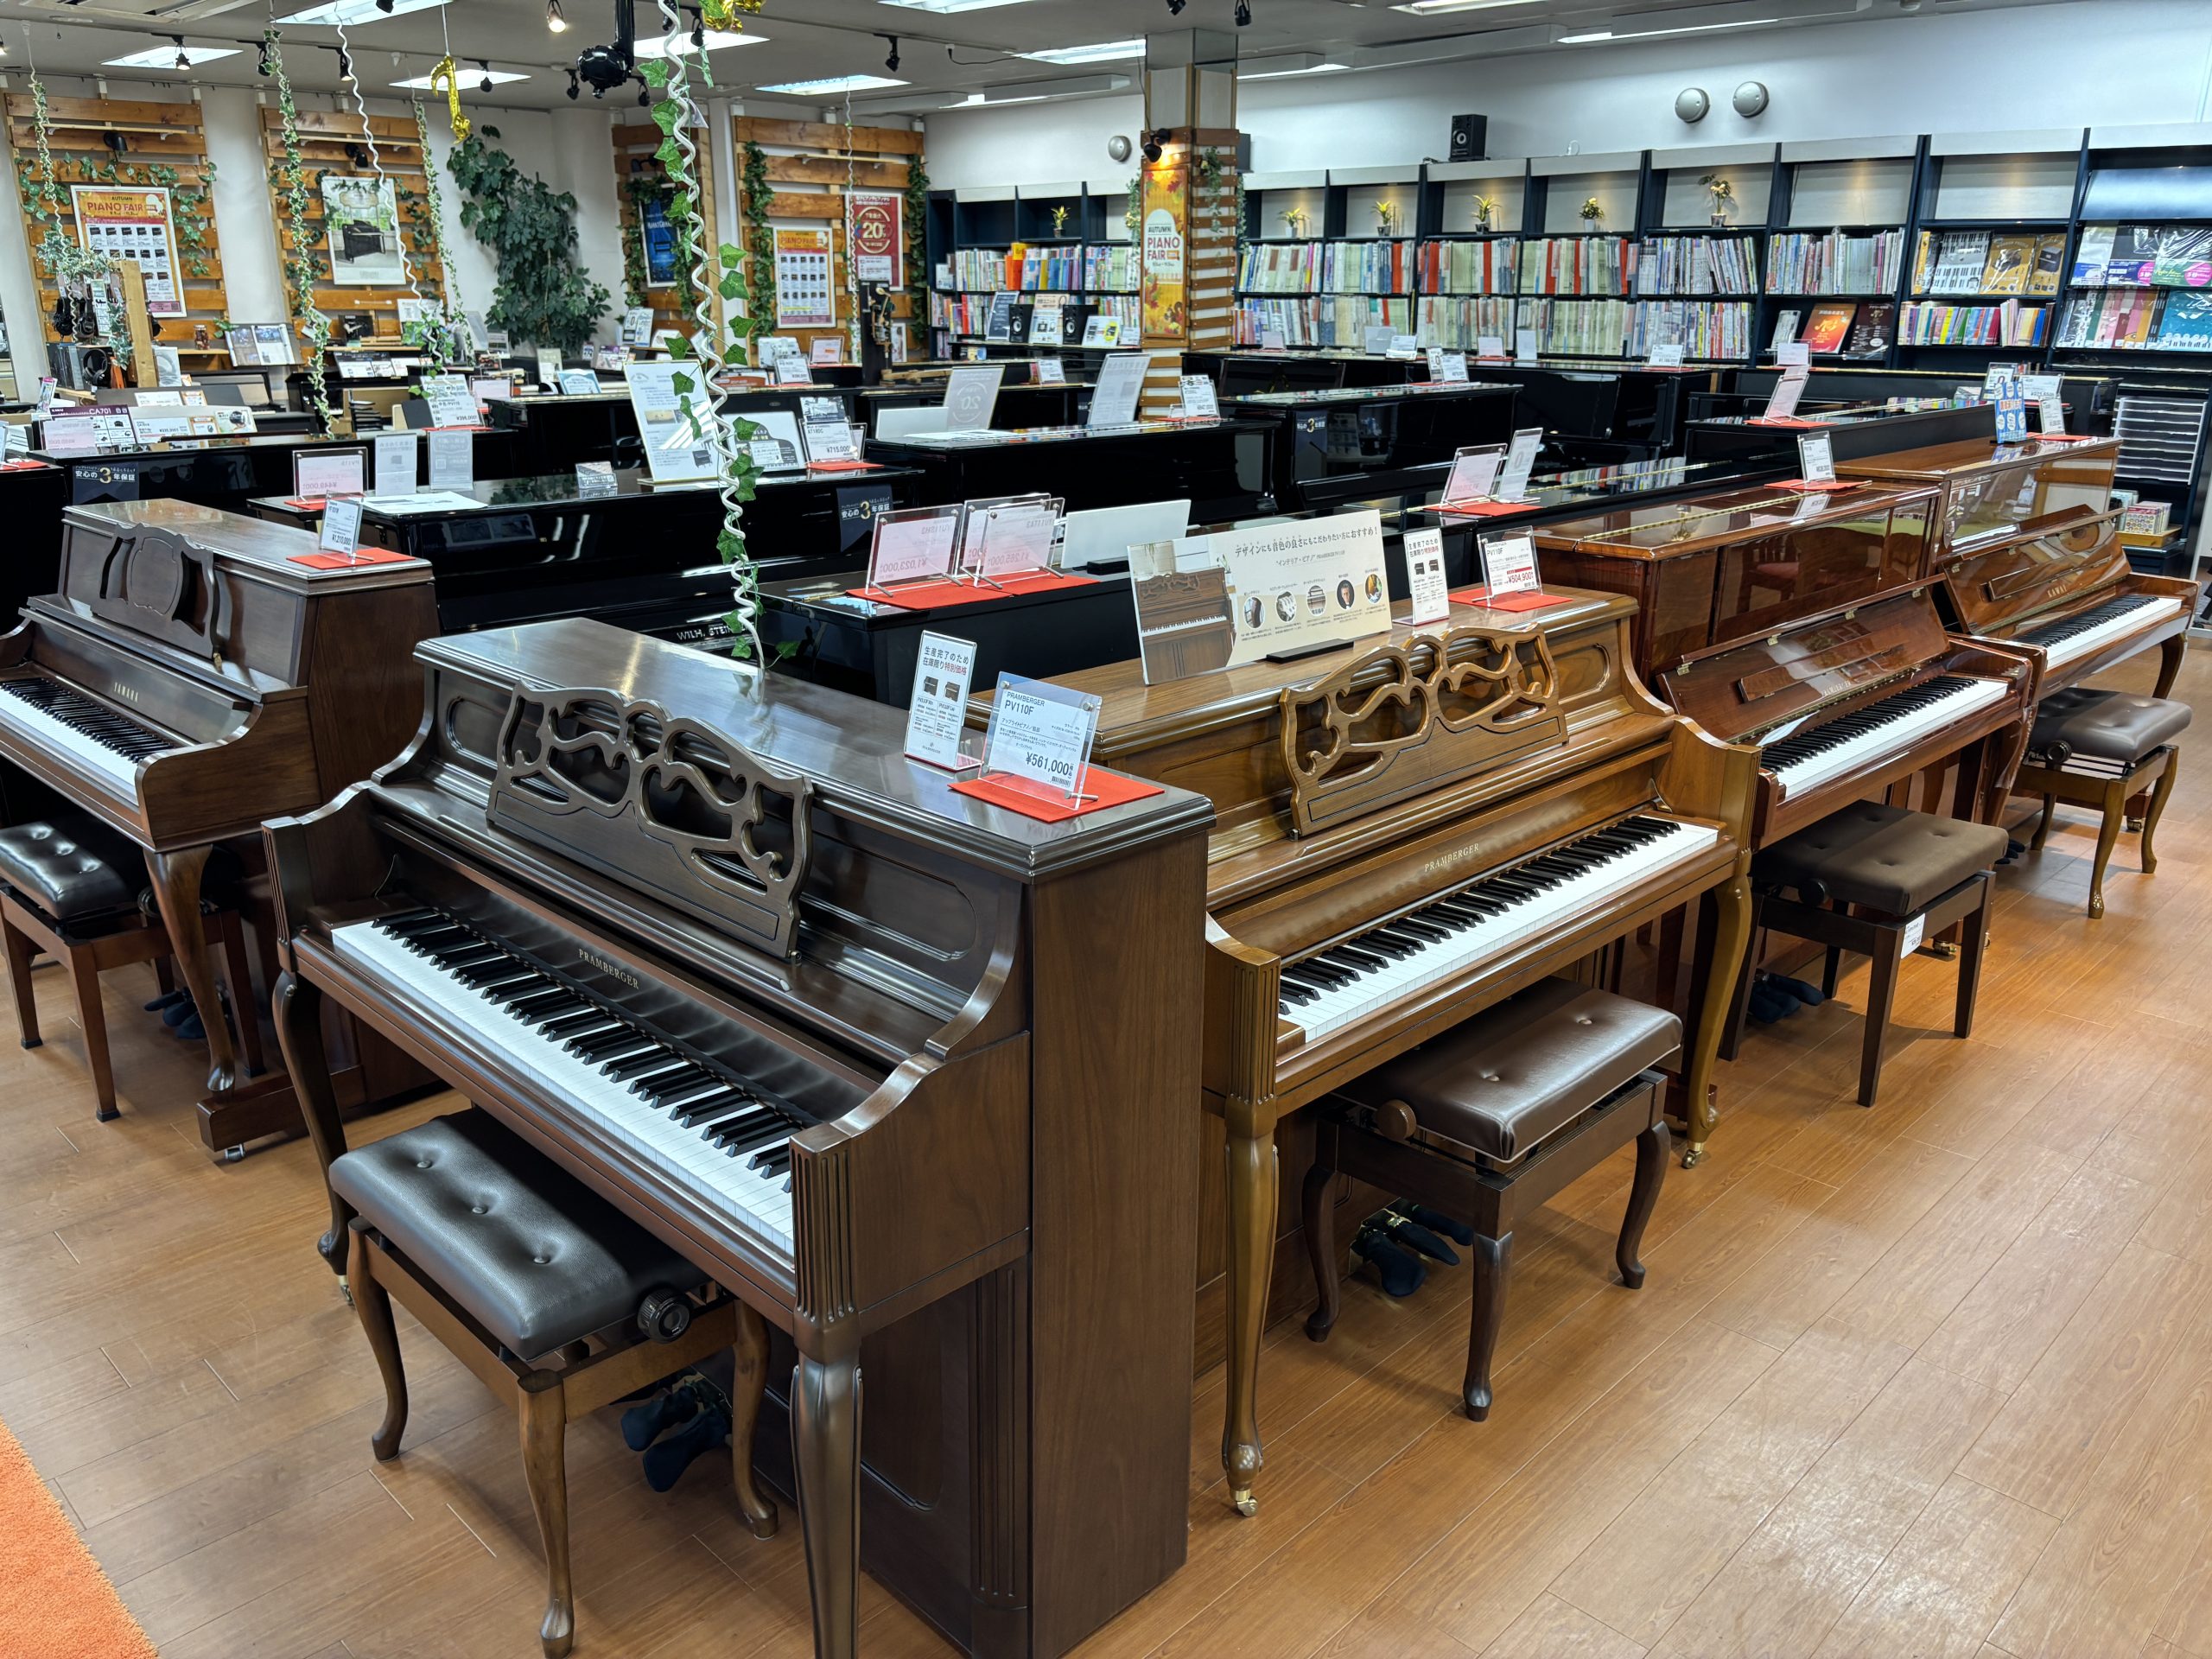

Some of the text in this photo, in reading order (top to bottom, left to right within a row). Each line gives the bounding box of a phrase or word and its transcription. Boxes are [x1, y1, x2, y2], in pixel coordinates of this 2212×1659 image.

[87, 202, 122, 211] PIANO
[1147, 237, 1180, 249] PIANO
[1147, 250, 1166, 260] FAIR
[1486, 547, 1503, 557] PV110F
[1507, 572, 1532, 584] ¥504,900
[2047, 584, 2068, 598] KAWAI
[677, 628, 706, 641] WILH.
[924, 645, 969, 665] 生産完了のため
[923, 657, 968, 676] 在庫限り特別価格
[1007, 691, 1046, 707] PRAMBERGER
[1004, 699, 1035, 715] PV110F
[1026, 751, 1070, 776] ¥561,000
[1425, 842, 1479, 873] PRAMBERGER
[578, 948, 639, 990] PRAMBERGER
